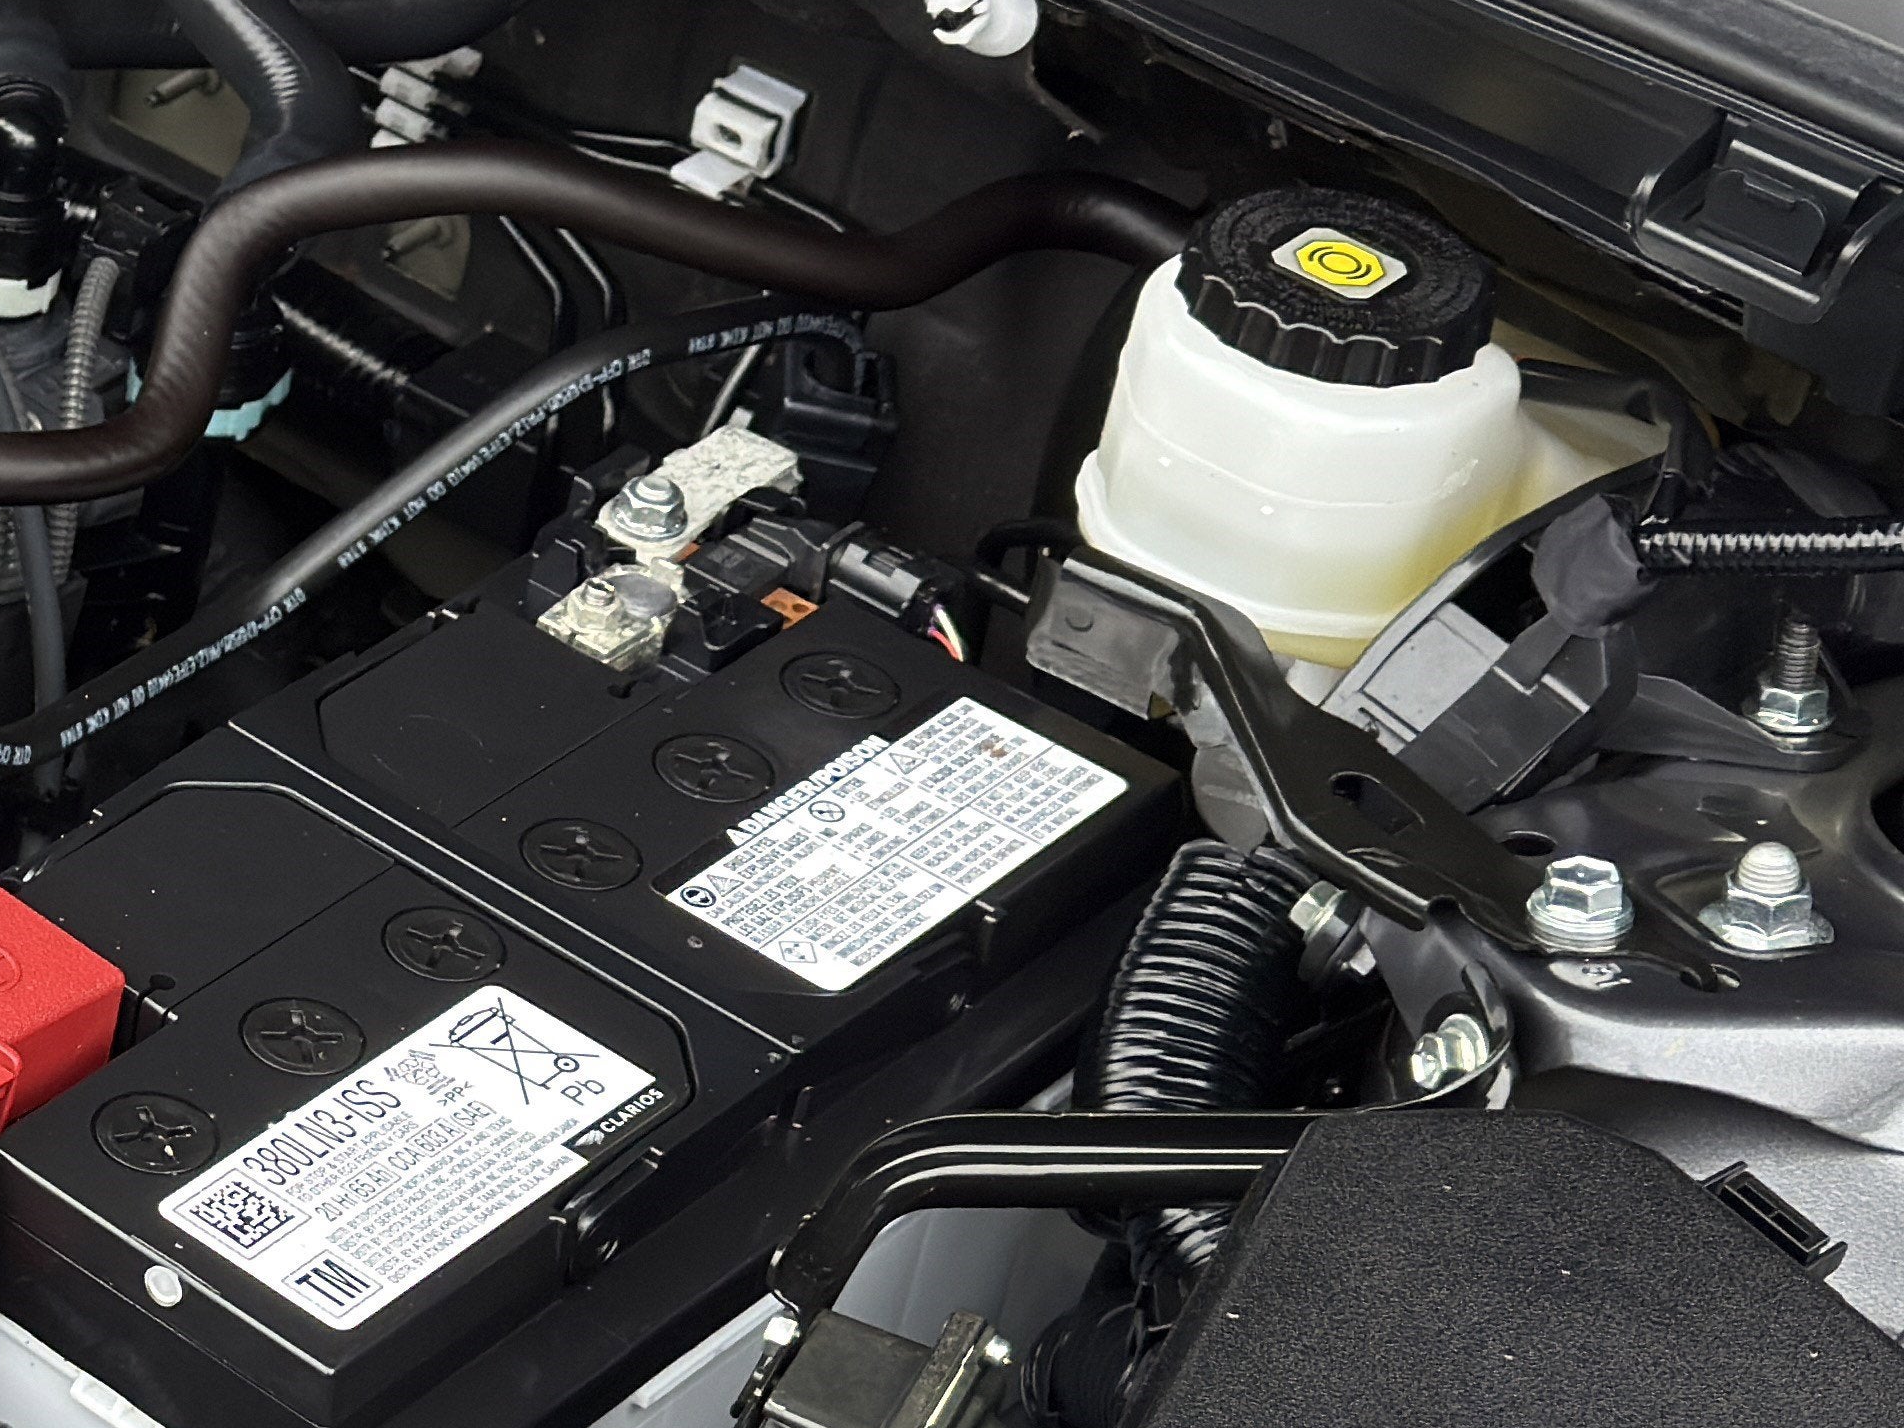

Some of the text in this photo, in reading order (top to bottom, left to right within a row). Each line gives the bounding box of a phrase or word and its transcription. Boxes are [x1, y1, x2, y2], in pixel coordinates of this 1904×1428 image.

[734, 733, 892, 835] DANGER/POISON
[557, 1072, 610, 1107] Pb
[444, 1096, 498, 1131] (SAE)
[600, 1087, 664, 1135] CLARIOS
[238, 1077, 404, 1188] 380LN3-ISS
[411, 1127, 450, 1154] 603
[435, 1121, 461, 1138] A
[300, 1164, 331, 1185] STOP
[331, 1141, 365, 1165] START
[384, 1143, 426, 1172] CCA
[345, 1176, 378, 1199] 65
[361, 1164, 395, 1187] Ah
[312, 1200, 345, 1223] 20
[328, 1189, 360, 1211] Hr
[293, 1256, 371, 1311] TM
